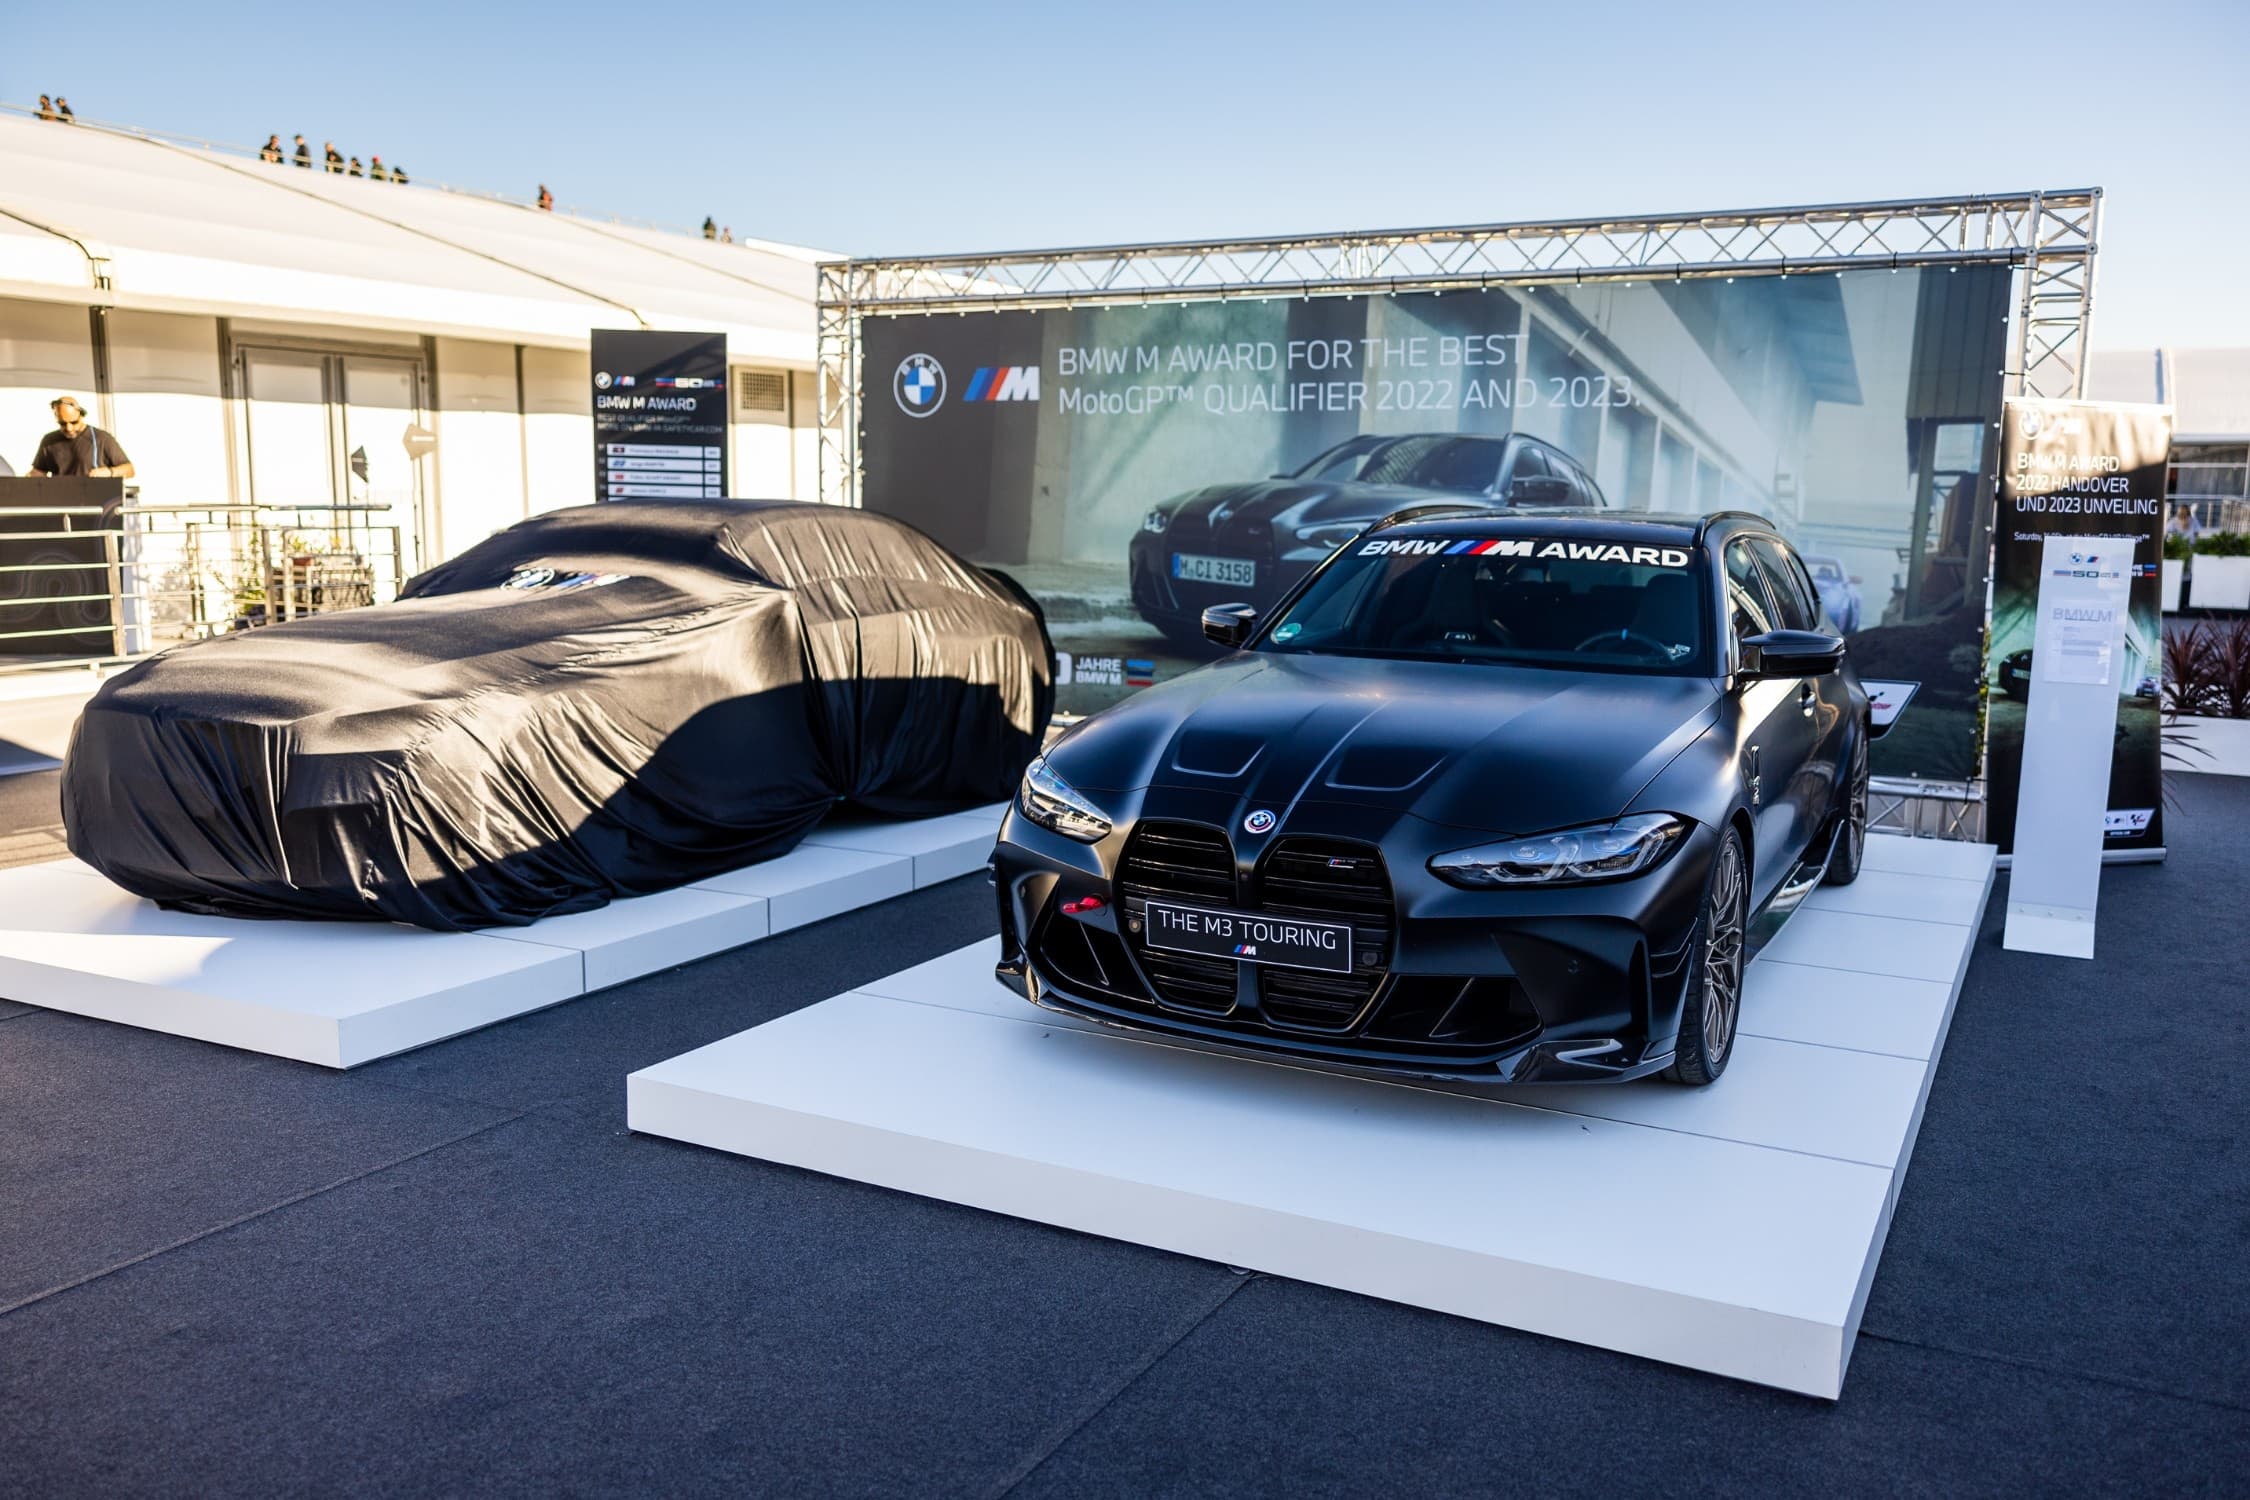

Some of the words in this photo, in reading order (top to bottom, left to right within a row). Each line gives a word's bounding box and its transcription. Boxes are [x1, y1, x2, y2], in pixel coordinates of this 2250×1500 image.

[1059, 346, 1129, 376] BMW
[1136, 345, 1159, 374] M
[1167, 342, 1277, 374] AWARD
[1287, 339, 1353, 371] FOR
[1360, 337, 1429, 369] THE
[1440, 334, 1529, 367] BEST
[597, 395, 631, 409] BMW
[633, 397, 645, 409] M
[647, 397, 697, 411] AWARD
[1059, 386, 1194, 415] MotoGP™
[1203, 381, 1369, 414] QUALIFIER
[1376, 380, 1452, 411] 2022
[1462, 378, 1538, 409] AND
[1550, 376, 1642, 408] 2023.
[2016, 452, 2052, 470] BMW
[2053, 453, 2066, 471] M
[2068, 454, 2120, 472] AWARD
[2016, 474, 2049, 491] 2022
[2051, 475, 2129, 493] HANDOVER
[2016, 496, 2046, 512] UND
[2048, 497, 2081, 513] 2023
[2084, 499, 2158, 515] UNVEILING
[1358, 540, 1450, 556] BMW
[1481, 540, 1535, 557] M
[1537, 542, 1689, 568] AWARD
[1216, 562, 1252, 583] 3158
[2052, 607, 2095, 621] BMW
[2097, 610, 2112, 622] M
[1075, 658, 1122, 672] JAHRE
[1075, 671, 1107, 684] BMW
[1109, 673, 1122, 685] M
[1157, 909, 1199, 932] THE
[1205, 916, 1233, 937] M3
[1238, 920, 1336, 950] TOURING
